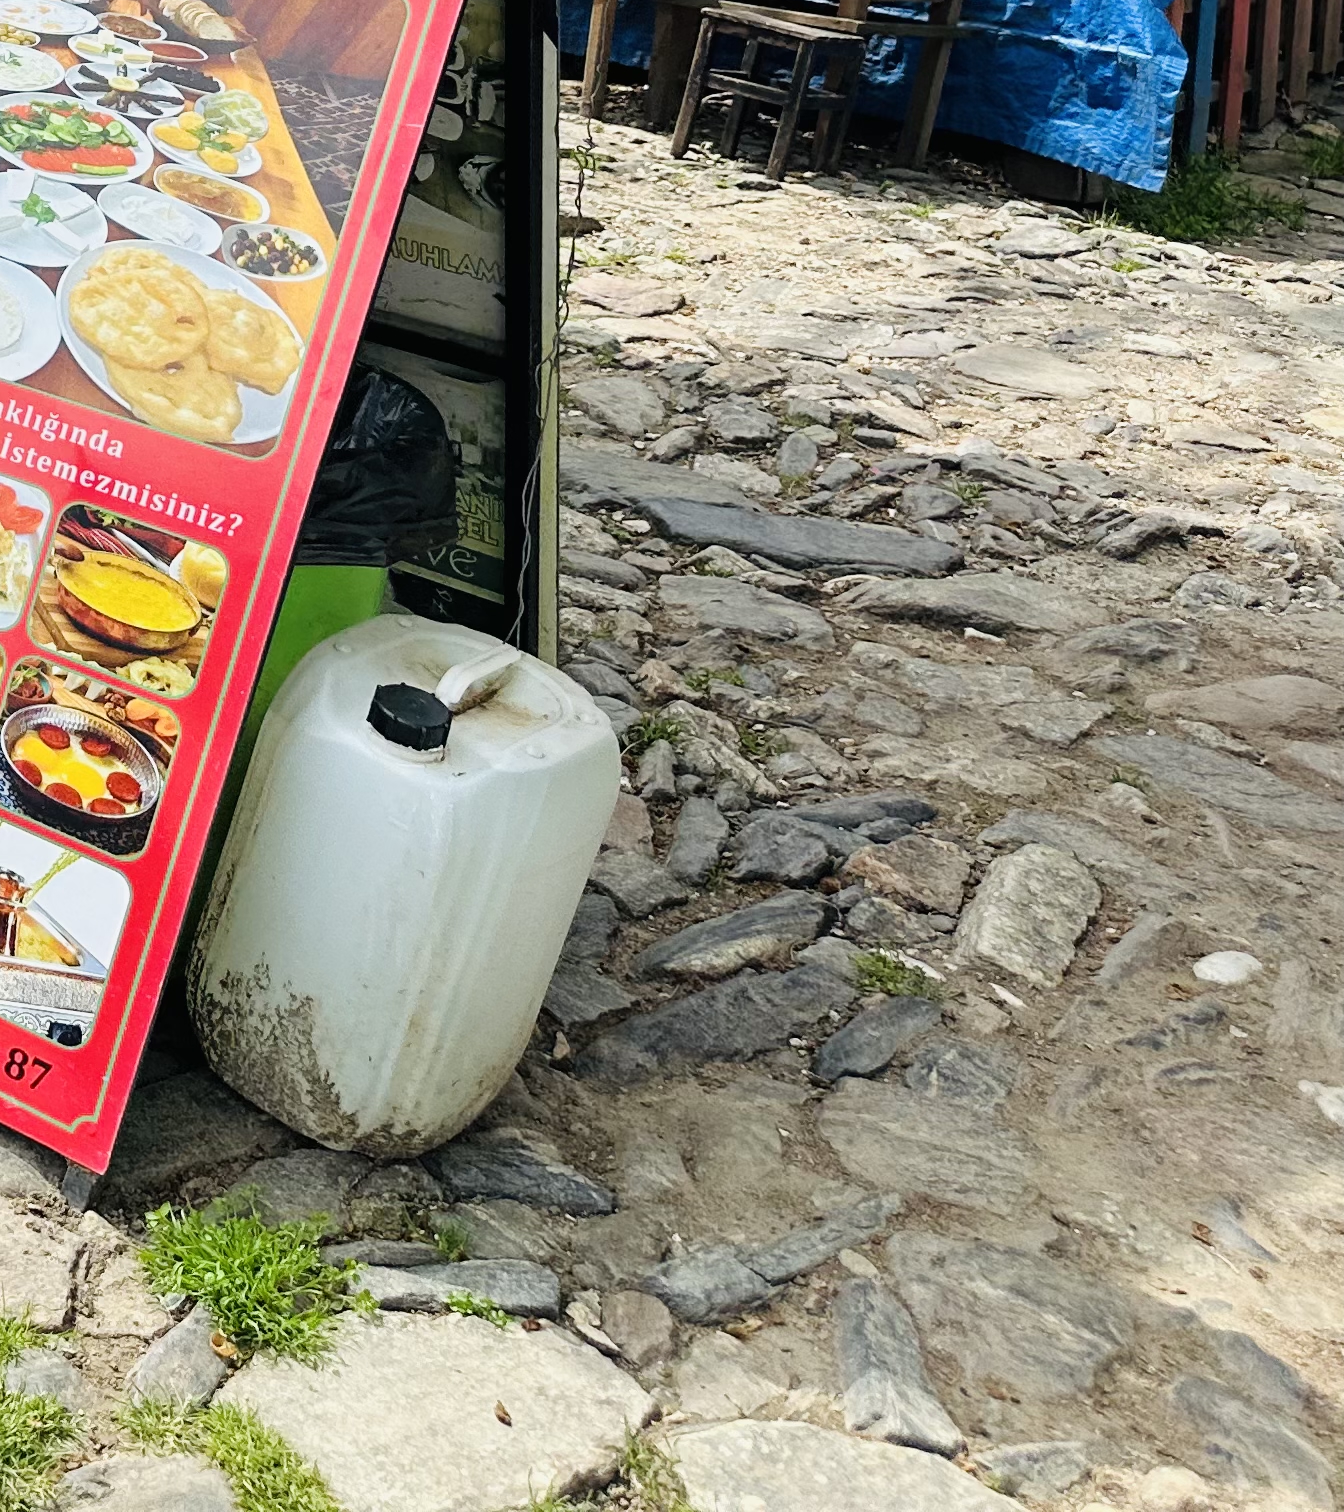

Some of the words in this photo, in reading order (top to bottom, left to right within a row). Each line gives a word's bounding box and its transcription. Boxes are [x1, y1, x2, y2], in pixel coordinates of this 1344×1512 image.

[390, 237, 505, 286] UHLAM
[0, 433, 244, 538] İstemezmisiniz?
[3, 1046, 53, 1091] 87
